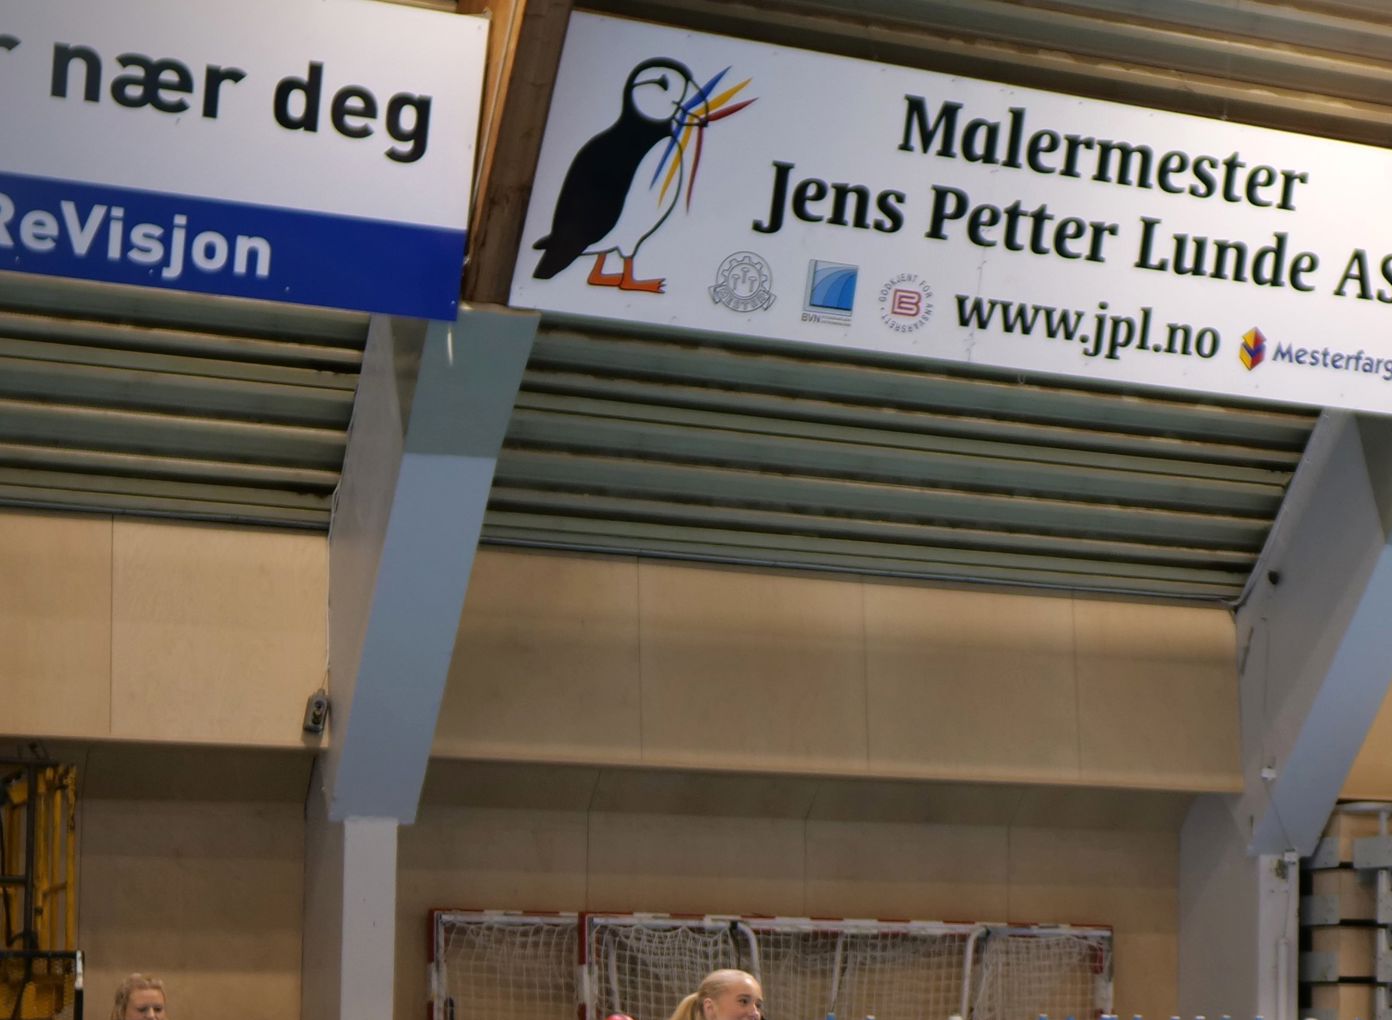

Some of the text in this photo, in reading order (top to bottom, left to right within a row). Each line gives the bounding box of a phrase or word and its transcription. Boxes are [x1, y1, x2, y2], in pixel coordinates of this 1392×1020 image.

[51, 42, 433, 163] nær deg
[897, 93, 1308, 211] Malermester
[752, 160, 906, 235] Jens
[925, 184, 1119, 263] Petter
[1134, 217, 1320, 293] Lunde
[955, 294, 1220, 360] www.jpl.no
